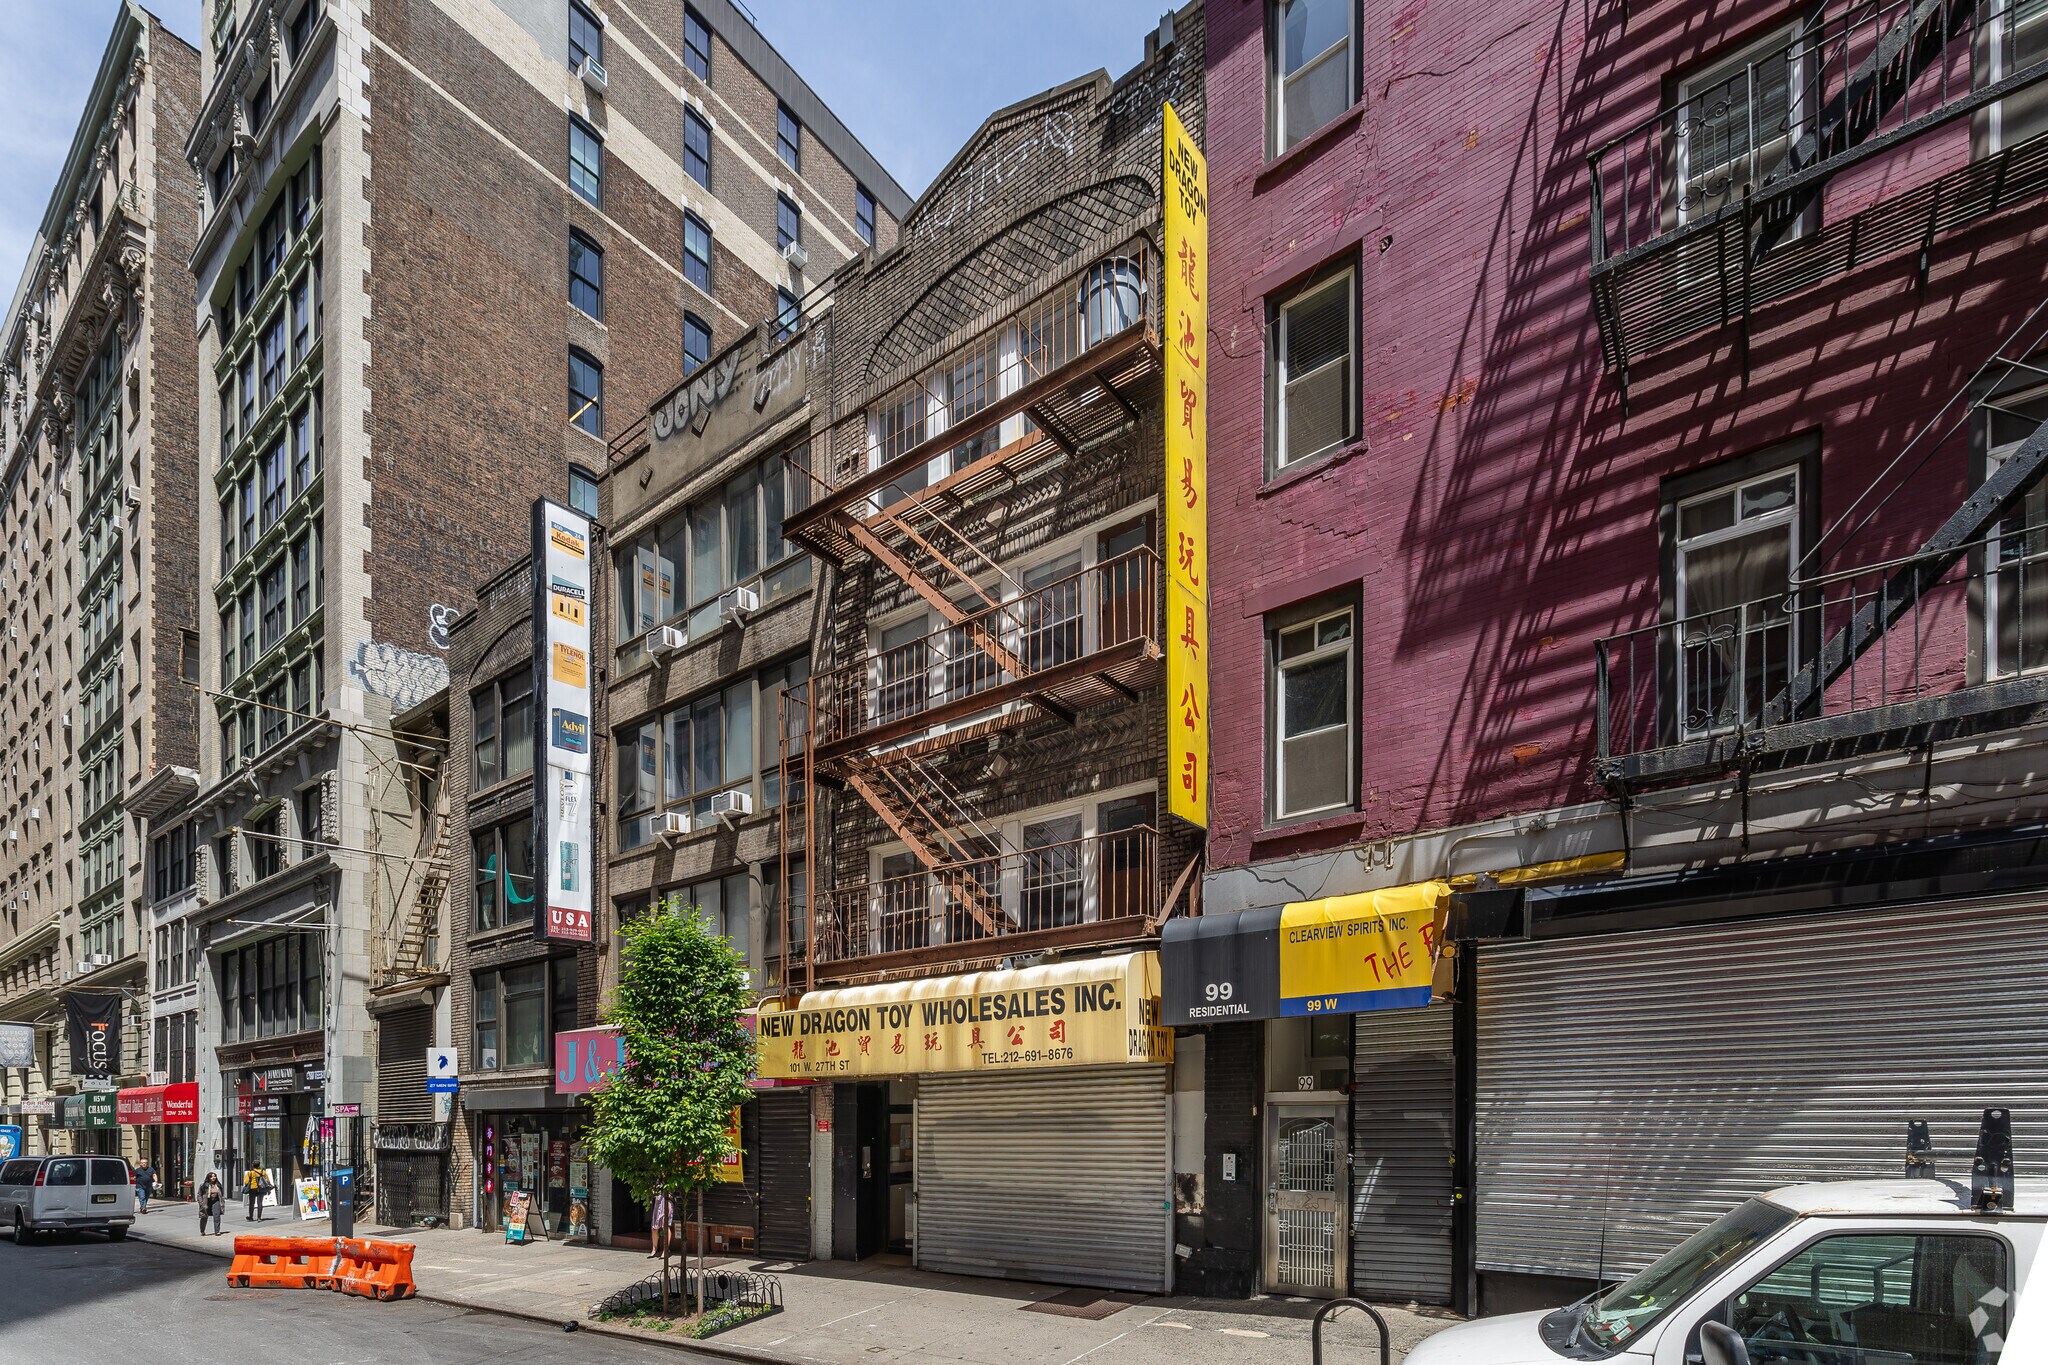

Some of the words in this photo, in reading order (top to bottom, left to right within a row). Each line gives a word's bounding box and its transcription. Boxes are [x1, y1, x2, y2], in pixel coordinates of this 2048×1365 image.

[1178, 137, 1198, 181] NEW
[1169, 147, 1206, 218] DRAGON
[1178, 185, 1197, 226] TOY
[1177, 235, 1201, 803] 龍池貿易玩具公司
[556, 531, 580, 548] Kodak
[553, 584, 585, 597] DURACELL
[560, 644, 585, 661] TYLENOL
[561, 719, 585, 736] Advil
[552, 910, 588, 928] USA
[1289, 924, 1344, 944] CLEARVIEW
[1347, 919, 1385, 937] SPIRITS
[1388, 917, 1409, 932] INC.
[1364, 941, 1414, 983] THE
[1205, 982, 1233, 1002] 99
[760, 1015, 795, 1038] NEW
[800, 1007, 871, 1035] DRAGON
[877, 1003, 913, 1030] TOY
[922, 988, 1066, 1026] WHOLESALES
[1074, 983, 1122, 1013] INC.
[1139, 997, 1159, 1027] NEW
[1189, 1003, 1250, 1018] RESIDENTIAL
[1307, 1000, 1321, 1011] 99
[1324, 998, 1338, 1010] W
[792, 1019, 1067, 1059] 龍池貿易玩具公司
[1129, 1028, 1155, 1057] DRAGON
[1157, 1030, 1168, 1057] TOY
[559, 1041, 578, 1084] J
[584, 1039, 601, 1084] &
[790, 1063, 801, 1073] 101
[803, 1062, 813, 1072] W.
[815, 1061, 836, 1072] 27TH
[839, 1060, 850, 1071] ST
[1299, 1076, 1313, 1090] 99
[88, 1105, 112, 1114] CHANON
[166, 1100, 193, 1109] Wonderful
[335, 1105, 350, 1113] SPA
[93, 1117, 107, 1125] Inc.
[342, 1176, 348, 1185] P
